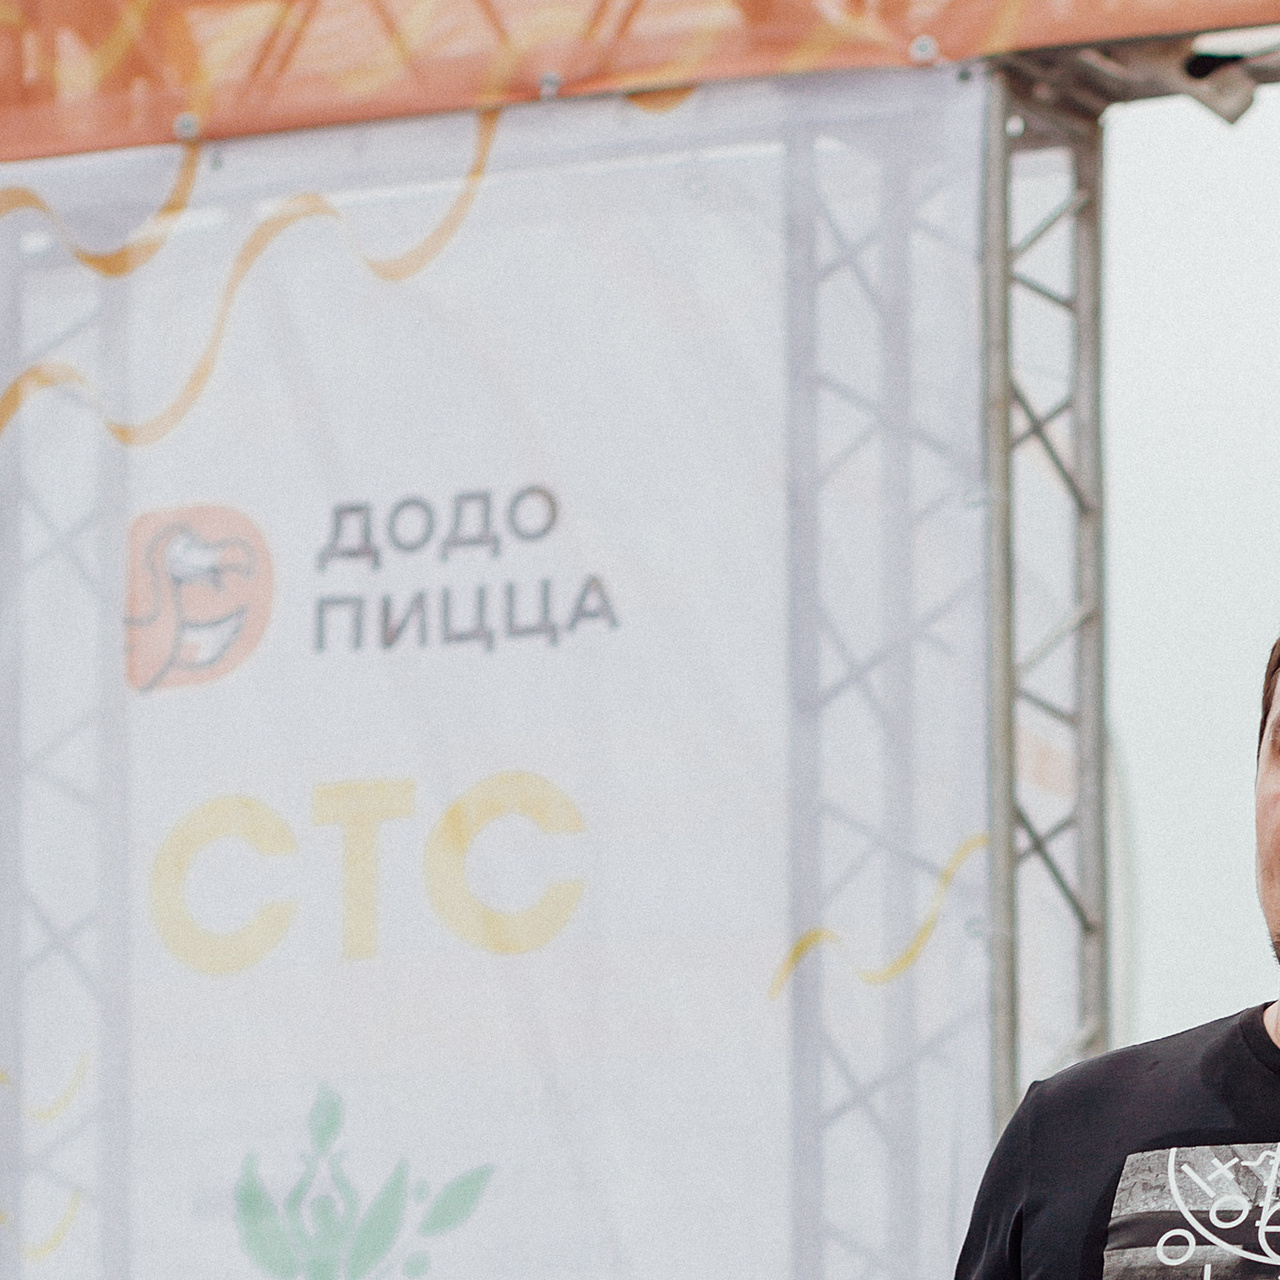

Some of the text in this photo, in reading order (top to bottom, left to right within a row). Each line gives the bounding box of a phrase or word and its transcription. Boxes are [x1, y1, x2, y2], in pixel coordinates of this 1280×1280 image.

[317, 485, 559, 571] ДОДО
[312, 574, 621, 655] ПИЦЦА
[150, 771, 586, 975] СТС
